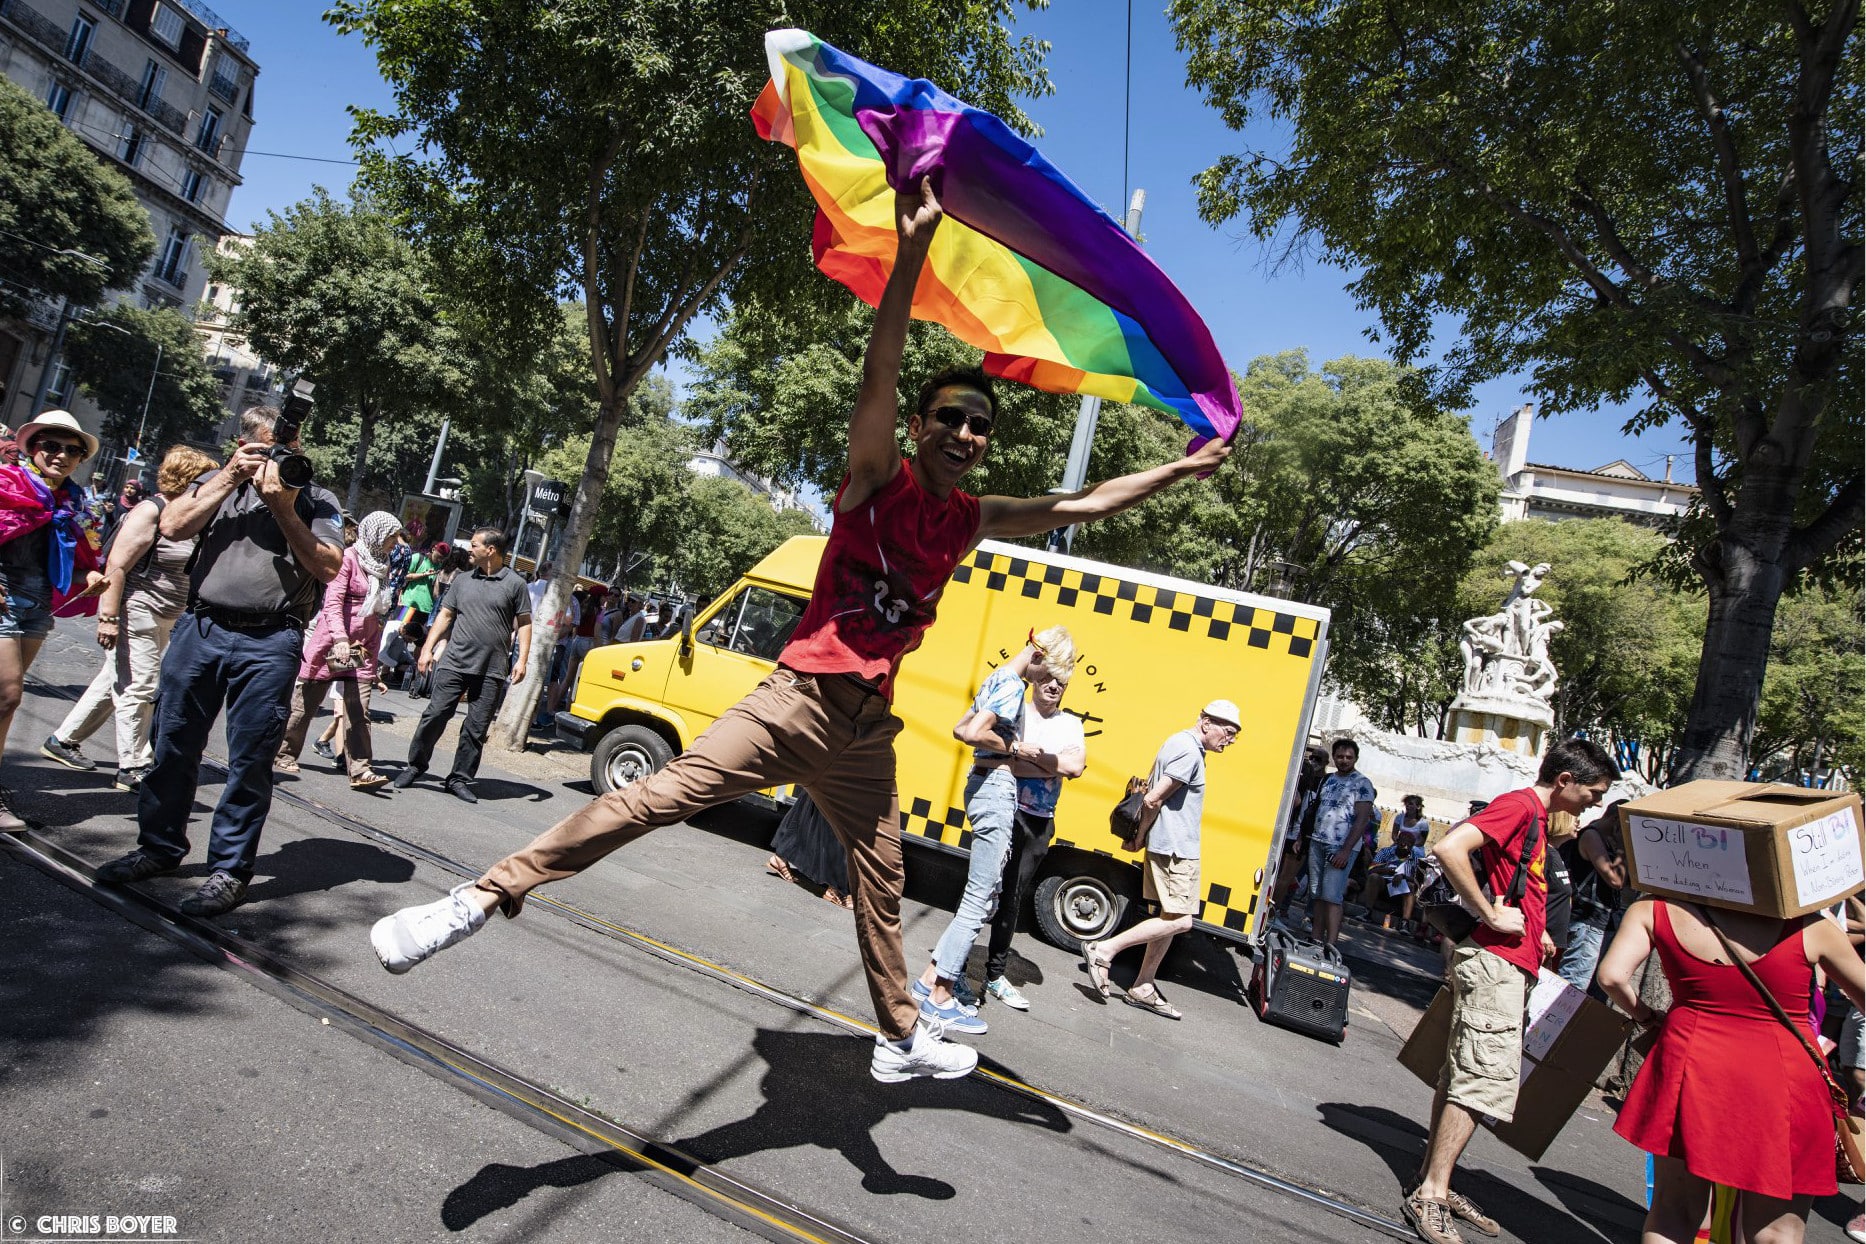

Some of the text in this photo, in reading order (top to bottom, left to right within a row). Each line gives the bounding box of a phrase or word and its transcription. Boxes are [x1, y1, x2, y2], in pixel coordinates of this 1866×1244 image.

[534, 486, 559, 502] Métro
[874, 580, 909, 623] 23
[987, 648, 1010, 669] LE
[1642, 819, 1685, 844] Still
[1796, 819, 1827, 854] Still
[1671, 849, 1710, 870] When
[1642, 864, 1669, 882] I'm
[1673, 873, 1701, 891] dating
